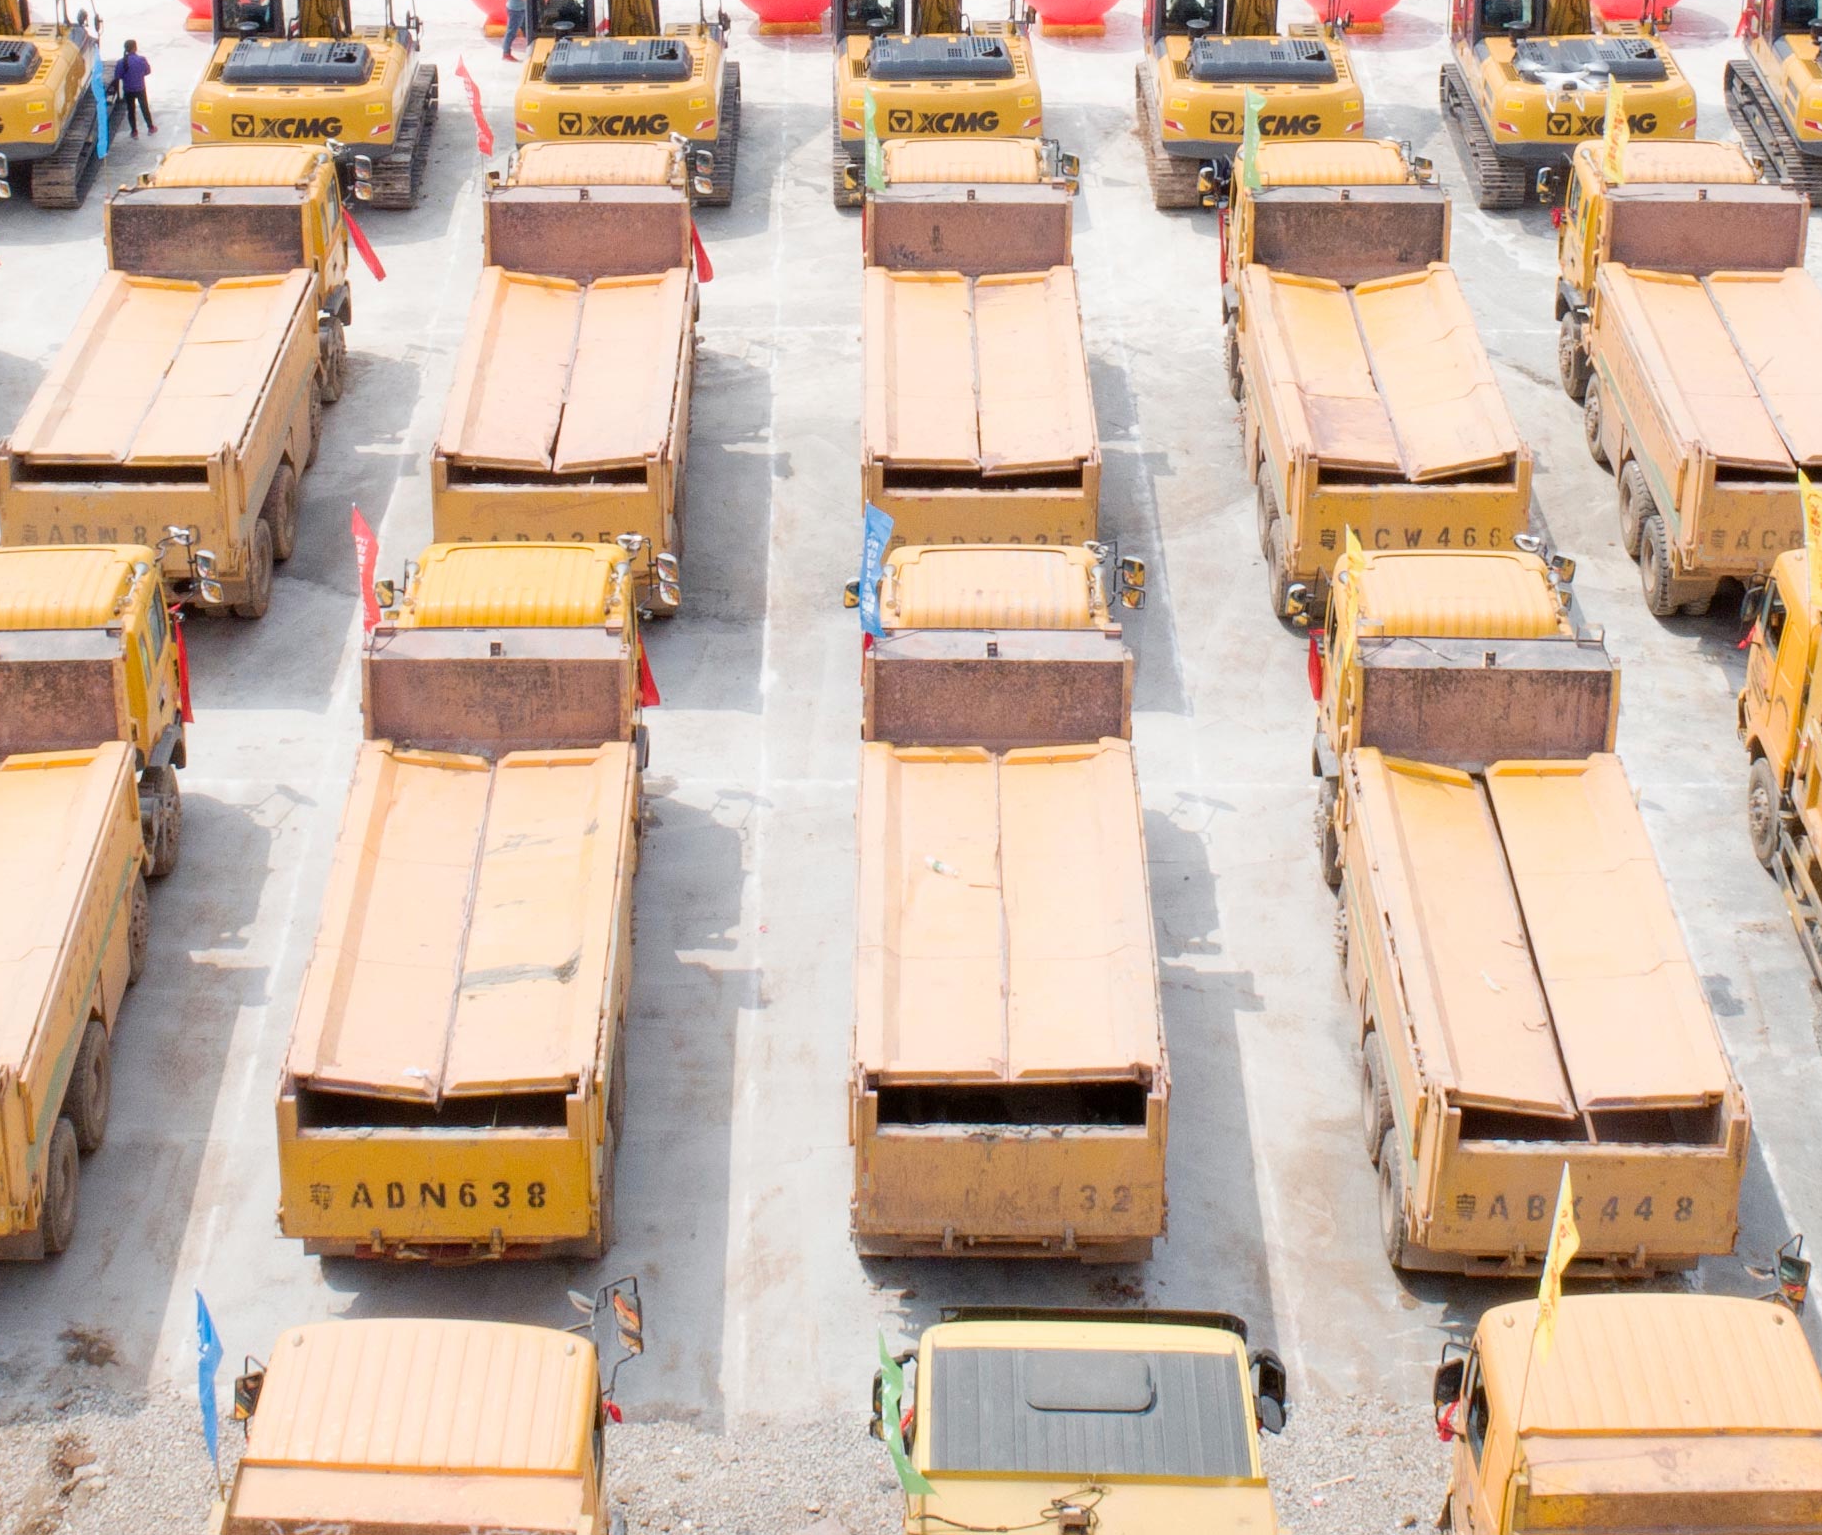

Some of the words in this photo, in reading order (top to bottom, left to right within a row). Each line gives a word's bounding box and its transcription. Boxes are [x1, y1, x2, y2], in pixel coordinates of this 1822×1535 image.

[258, 115, 343, 138] XCMG
[584, 115, 669, 138] XCMG
[914, 111, 999, 134] XCMG
[1249, 114, 1321, 137] CMG
[309, 1181, 547, 1212] 粤ADN638
